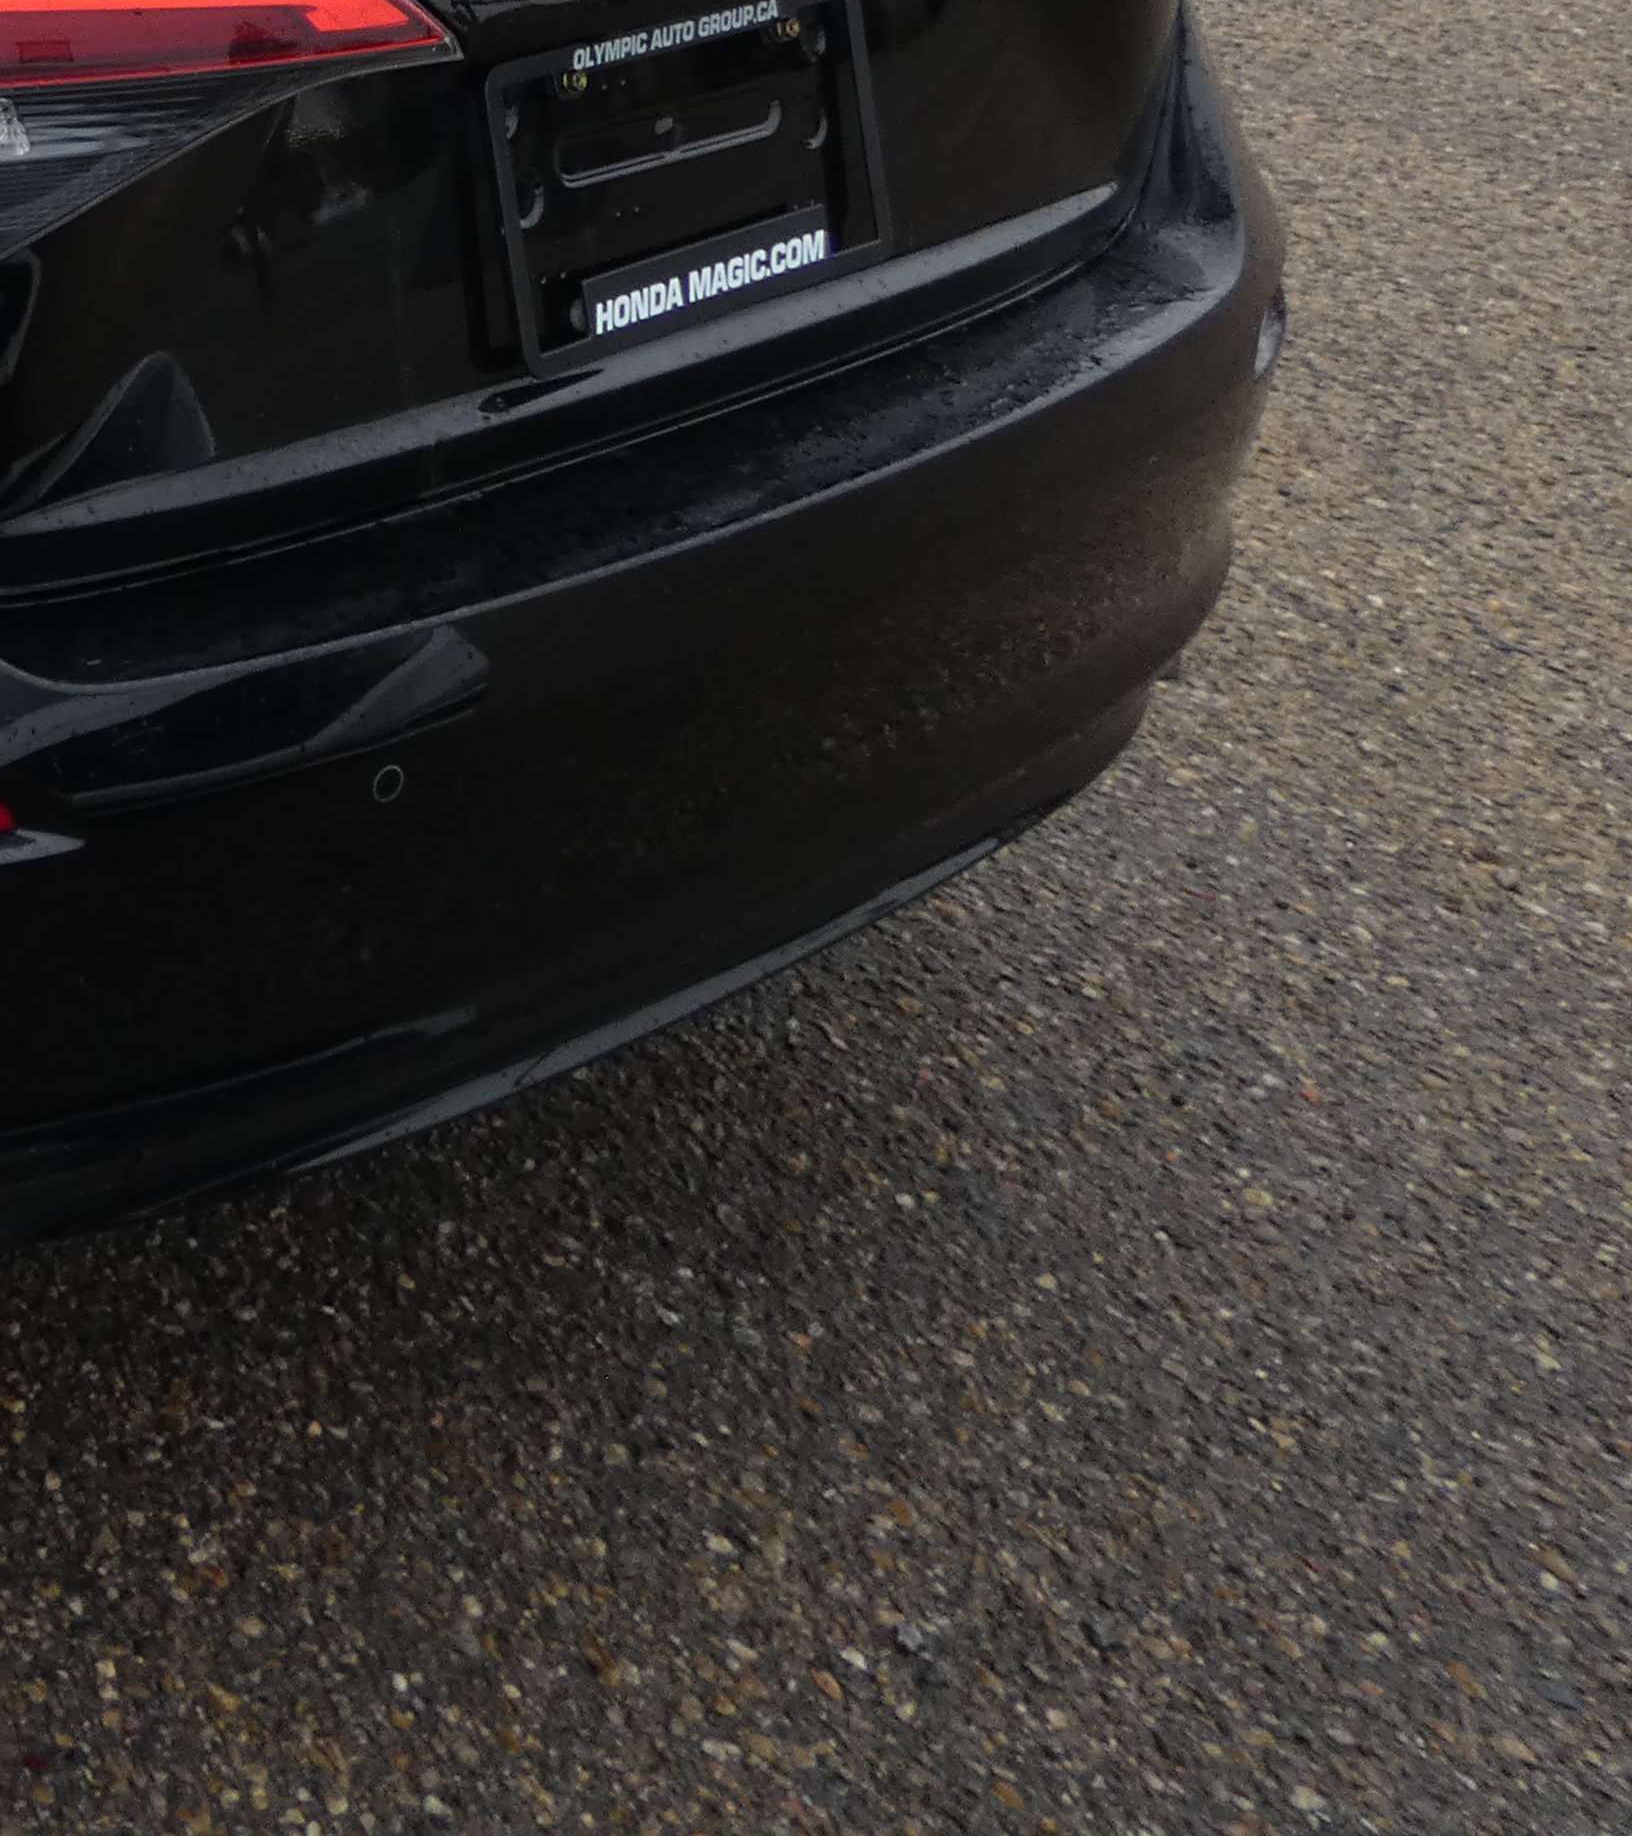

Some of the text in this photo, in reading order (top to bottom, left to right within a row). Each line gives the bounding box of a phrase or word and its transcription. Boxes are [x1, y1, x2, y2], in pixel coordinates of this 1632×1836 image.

[573, 32, 647, 71] OLYMPIC
[651, 20, 696, 52] AUTO
[595, 229, 826, 335] HONDA MAGIC.COM
